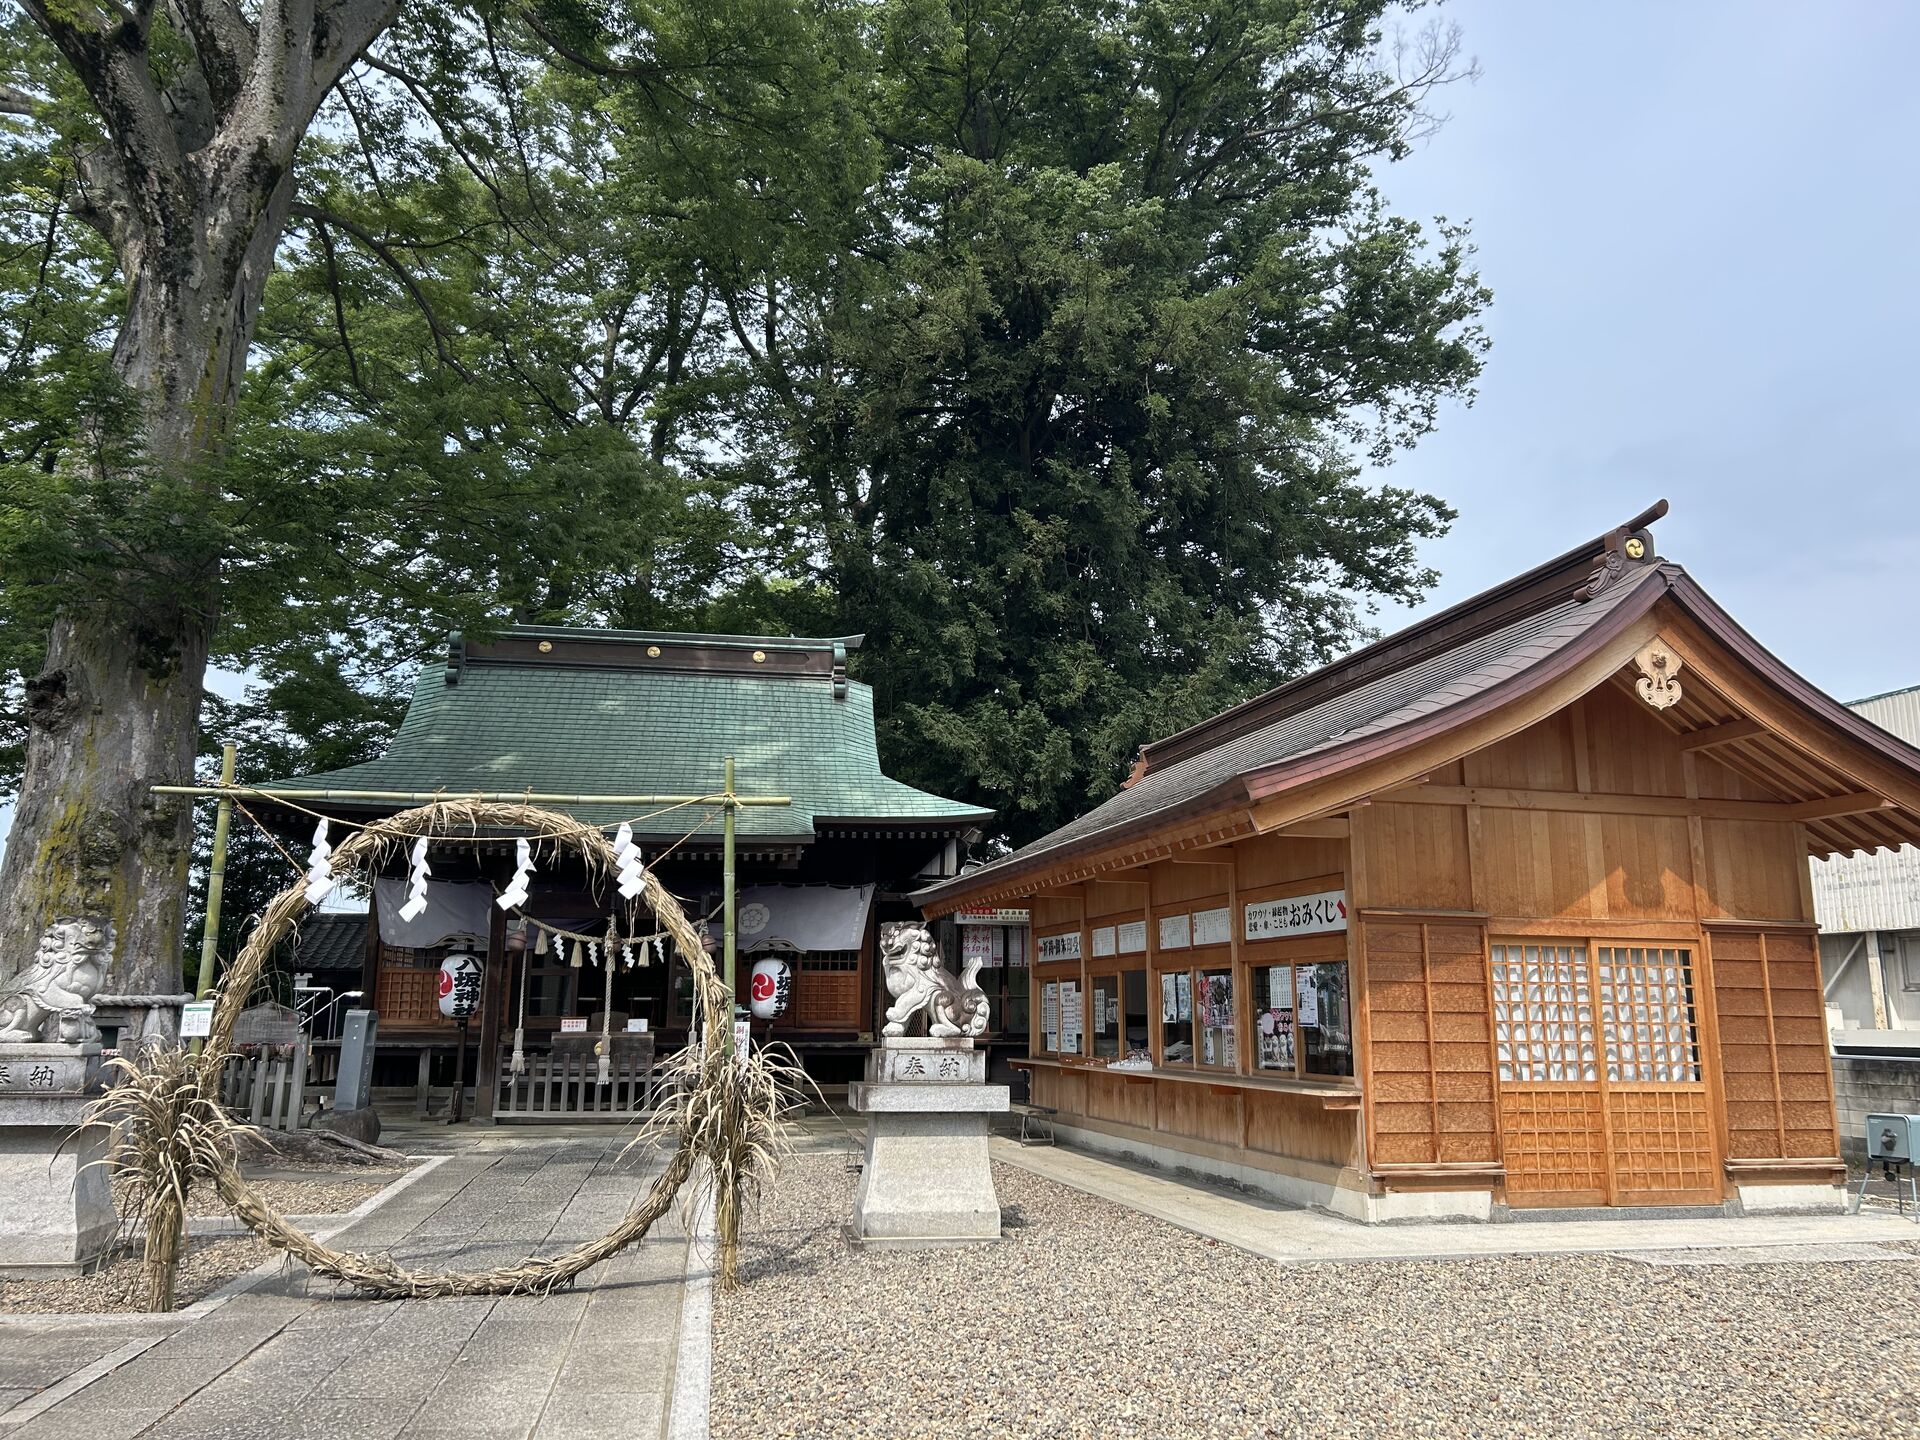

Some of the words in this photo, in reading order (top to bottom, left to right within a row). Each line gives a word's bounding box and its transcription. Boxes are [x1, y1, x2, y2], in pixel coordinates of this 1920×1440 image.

[1289, 899, 1337, 928] おみくじ
[451, 956, 483, 1016] 八坂神社
[903, 1055, 961, 1079] 奉納
